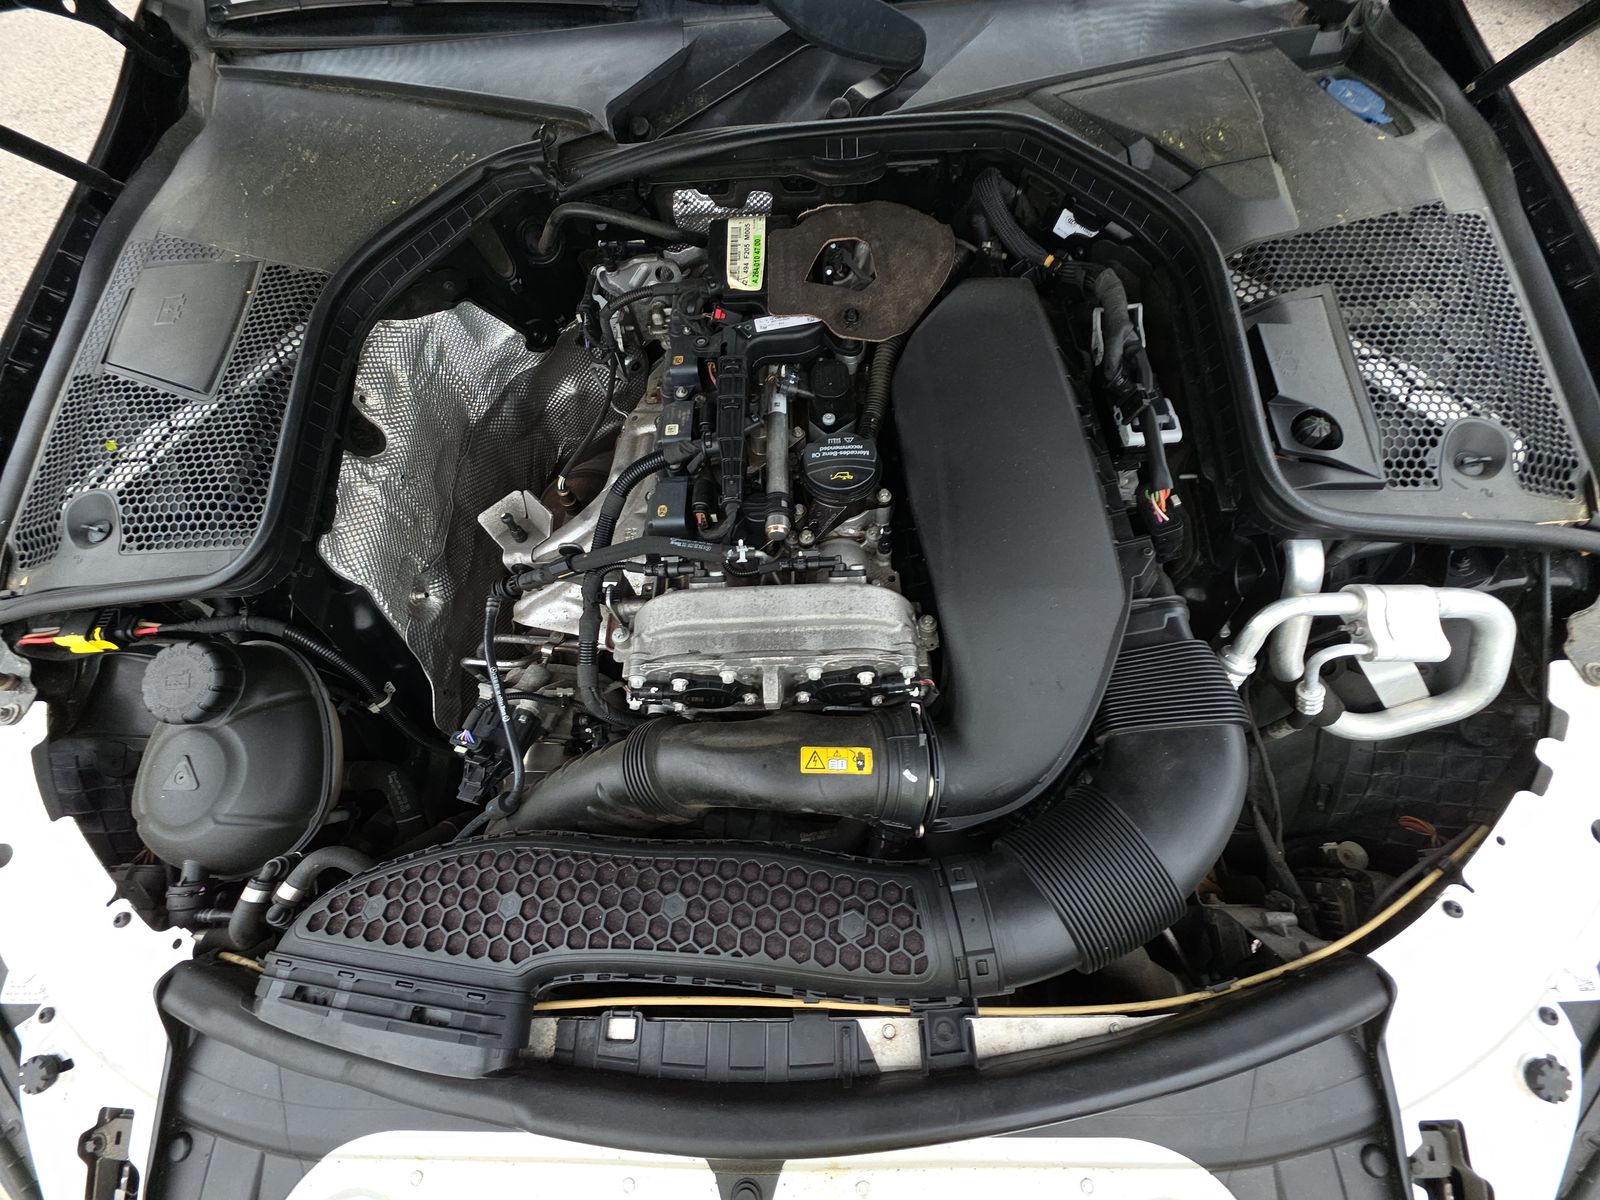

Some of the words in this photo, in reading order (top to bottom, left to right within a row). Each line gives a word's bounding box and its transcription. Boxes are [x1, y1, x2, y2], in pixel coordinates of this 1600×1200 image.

[743, 243, 751, 259] F205
[752, 267, 760, 278] 264
[819, 444, 863, 452] recommended
